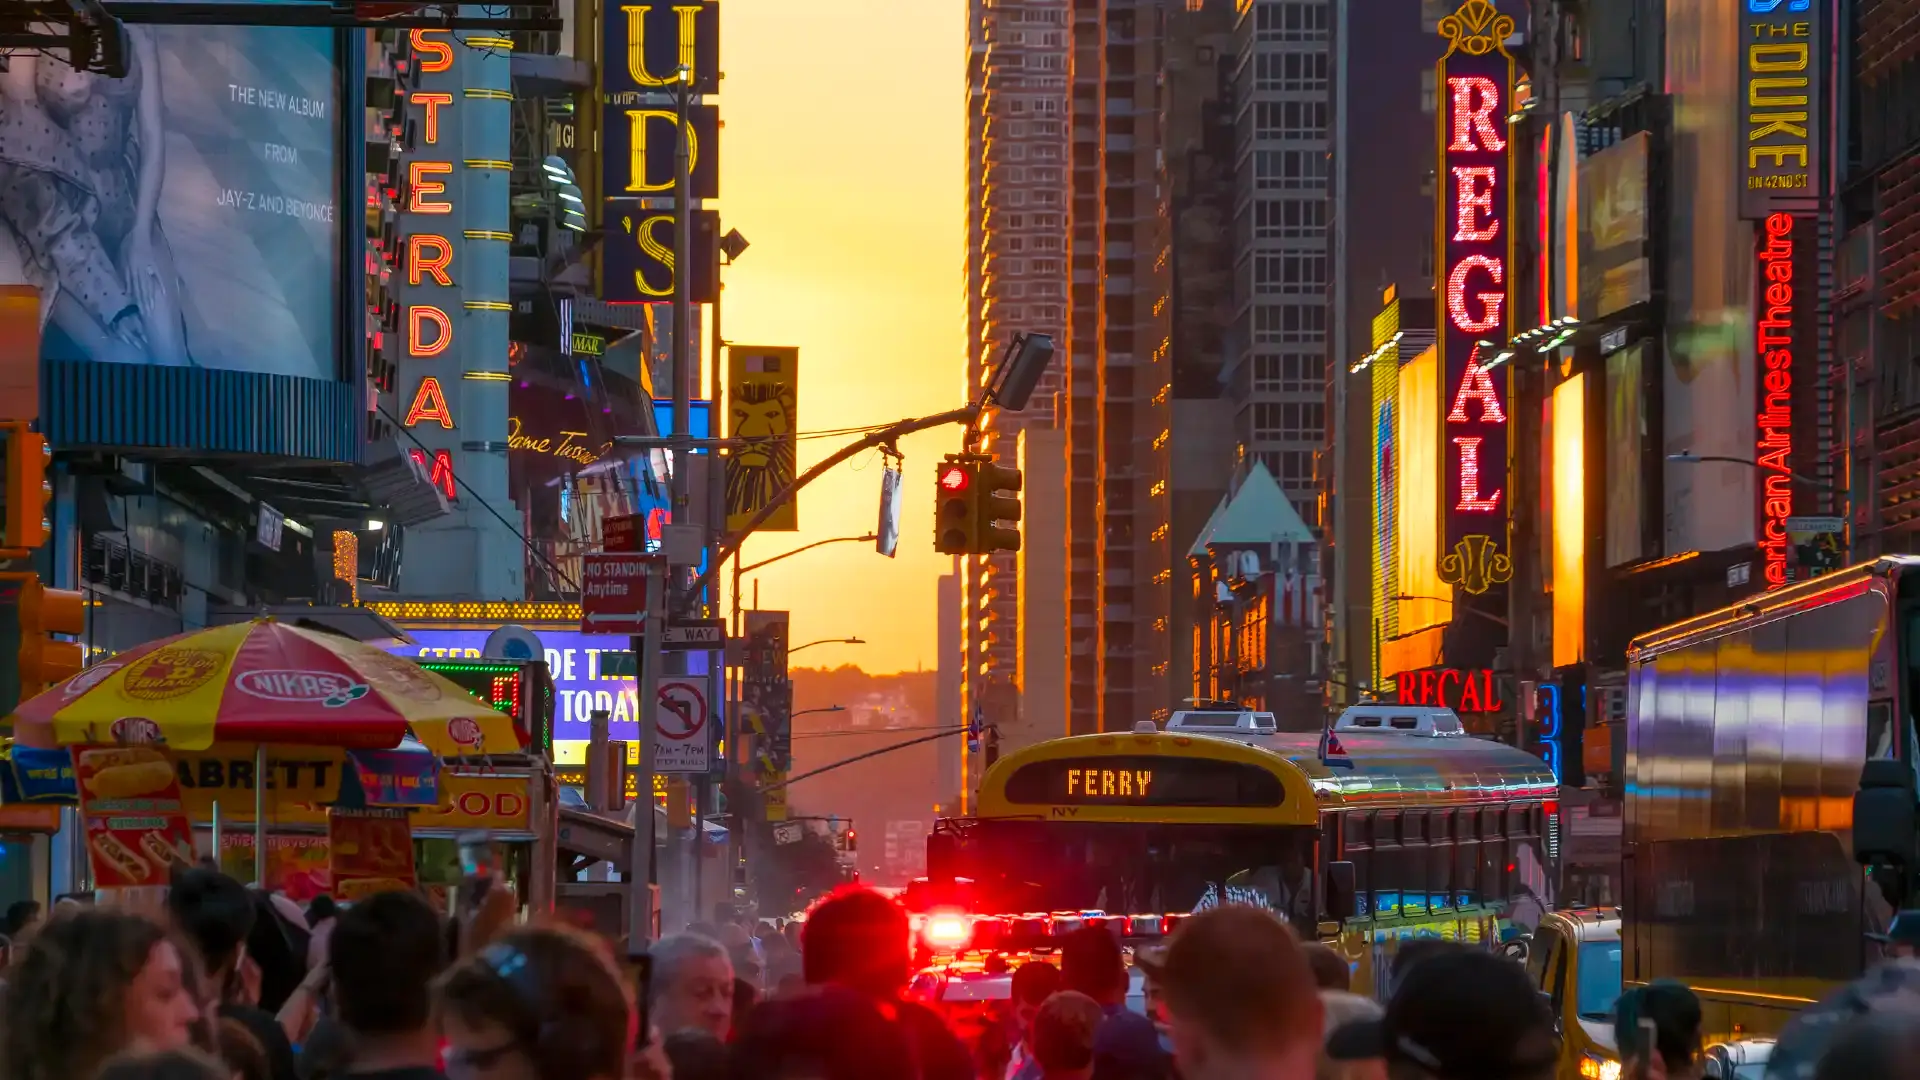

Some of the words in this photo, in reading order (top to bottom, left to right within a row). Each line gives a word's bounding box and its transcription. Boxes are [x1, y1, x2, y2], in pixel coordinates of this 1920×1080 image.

[1750, 22, 1811, 37] THE
[229, 84, 256, 105] THE
[258, 89, 287, 111] NEW
[288, 95, 325, 119] ALBUM
[1749, 43, 1808, 169] DUKE
[265, 142, 298, 165] FROM
[1795, 173, 1809, 187] ST
[217, 188, 256, 210] JAY-Z
[258, 194, 284, 214] AND
[286, 198, 334, 222] BEYONCÉ
[1758, 212, 1793, 353] Theatre
[1447, 77, 1507, 512] REGAL
[1757, 349, 1793, 475] Airlines
[1758, 475, 1792, 592] erican
[587, 562, 601, 577] NO
[603, 561, 650, 578] STANDIN
[587, 580, 629, 599] Anytime
[685, 628, 714, 641] WAY
[253, 673, 340, 696] NIKAS
[683, 743, 704, 756] 7PM
[1068, 769, 1151, 796] FERRY
[1052, 806, 1080, 818] NY
